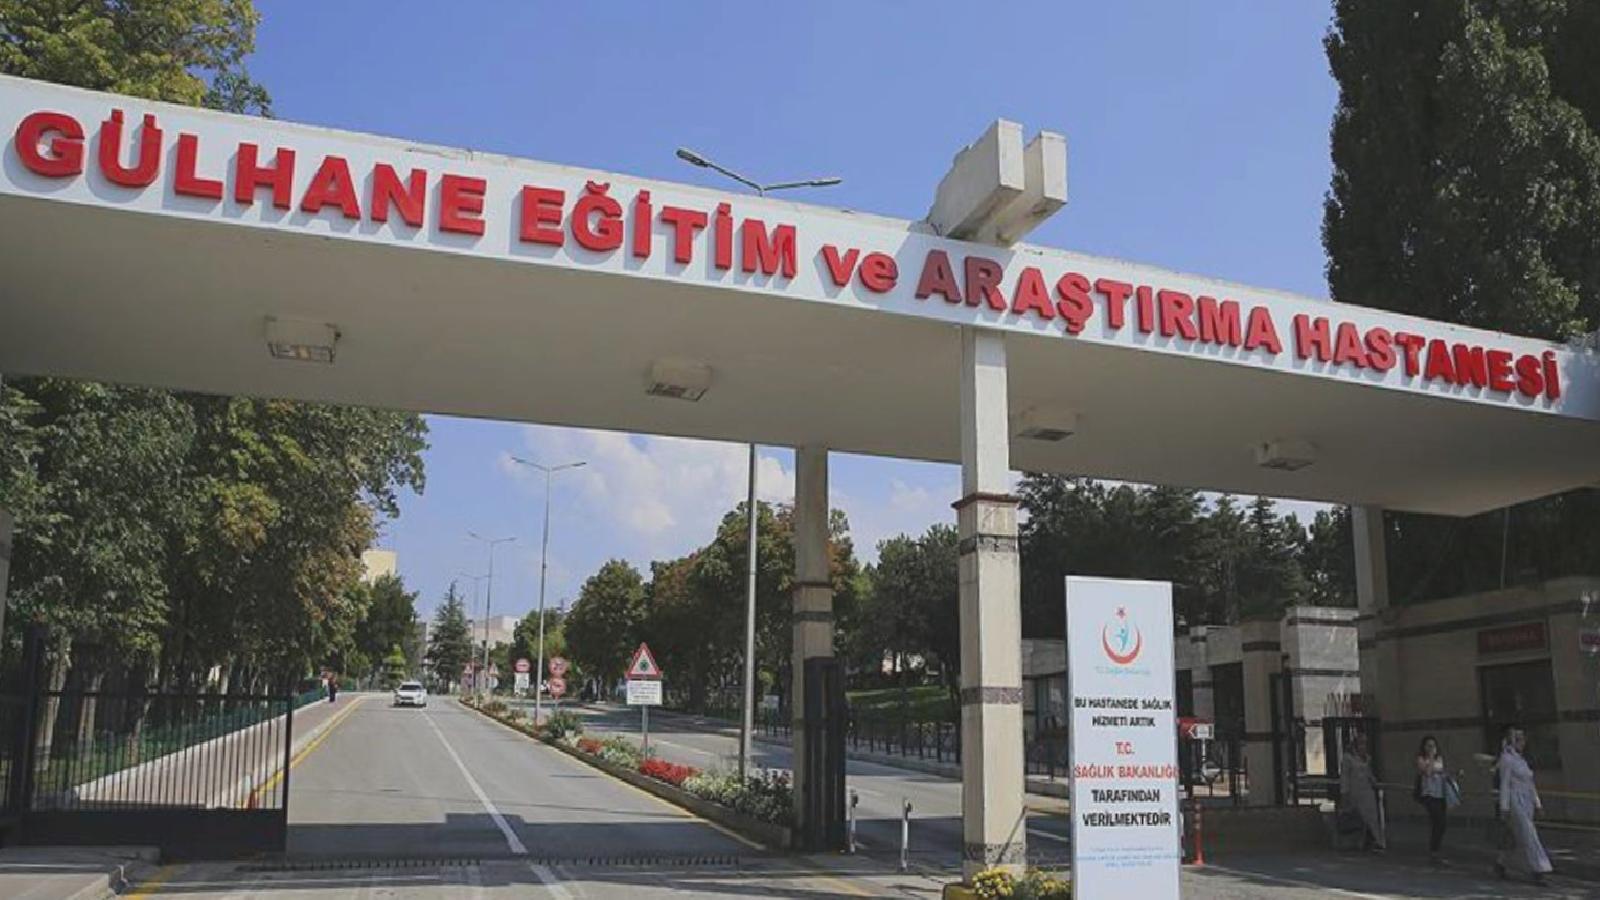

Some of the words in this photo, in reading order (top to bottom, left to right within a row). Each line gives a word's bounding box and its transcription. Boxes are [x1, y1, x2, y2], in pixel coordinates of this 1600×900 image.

[14, 109, 487, 236] GÜLHANE
[519, 180, 798, 280] EĞİTİM
[821, 243, 899, 293] ve
[915, 249, 1281, 354] ARAŞTIRMA
[1295, 312, 1562, 400] HASTANESİ
[1074, 696, 1087, 708] BU
[1089, 697, 1139, 709] HASTANEDE
[1141, 697, 1173, 710] SAĞLIK
[1115, 741, 1135, 754] T.C.
[1074, 764, 1114, 779] SAĞLIK
[1117, 765, 1179, 778] BAKANLIĞI
[1091, 789, 1160, 802] TARAFINDAN
[1082, 810, 1171, 826] VERİLMEKTEDİR
